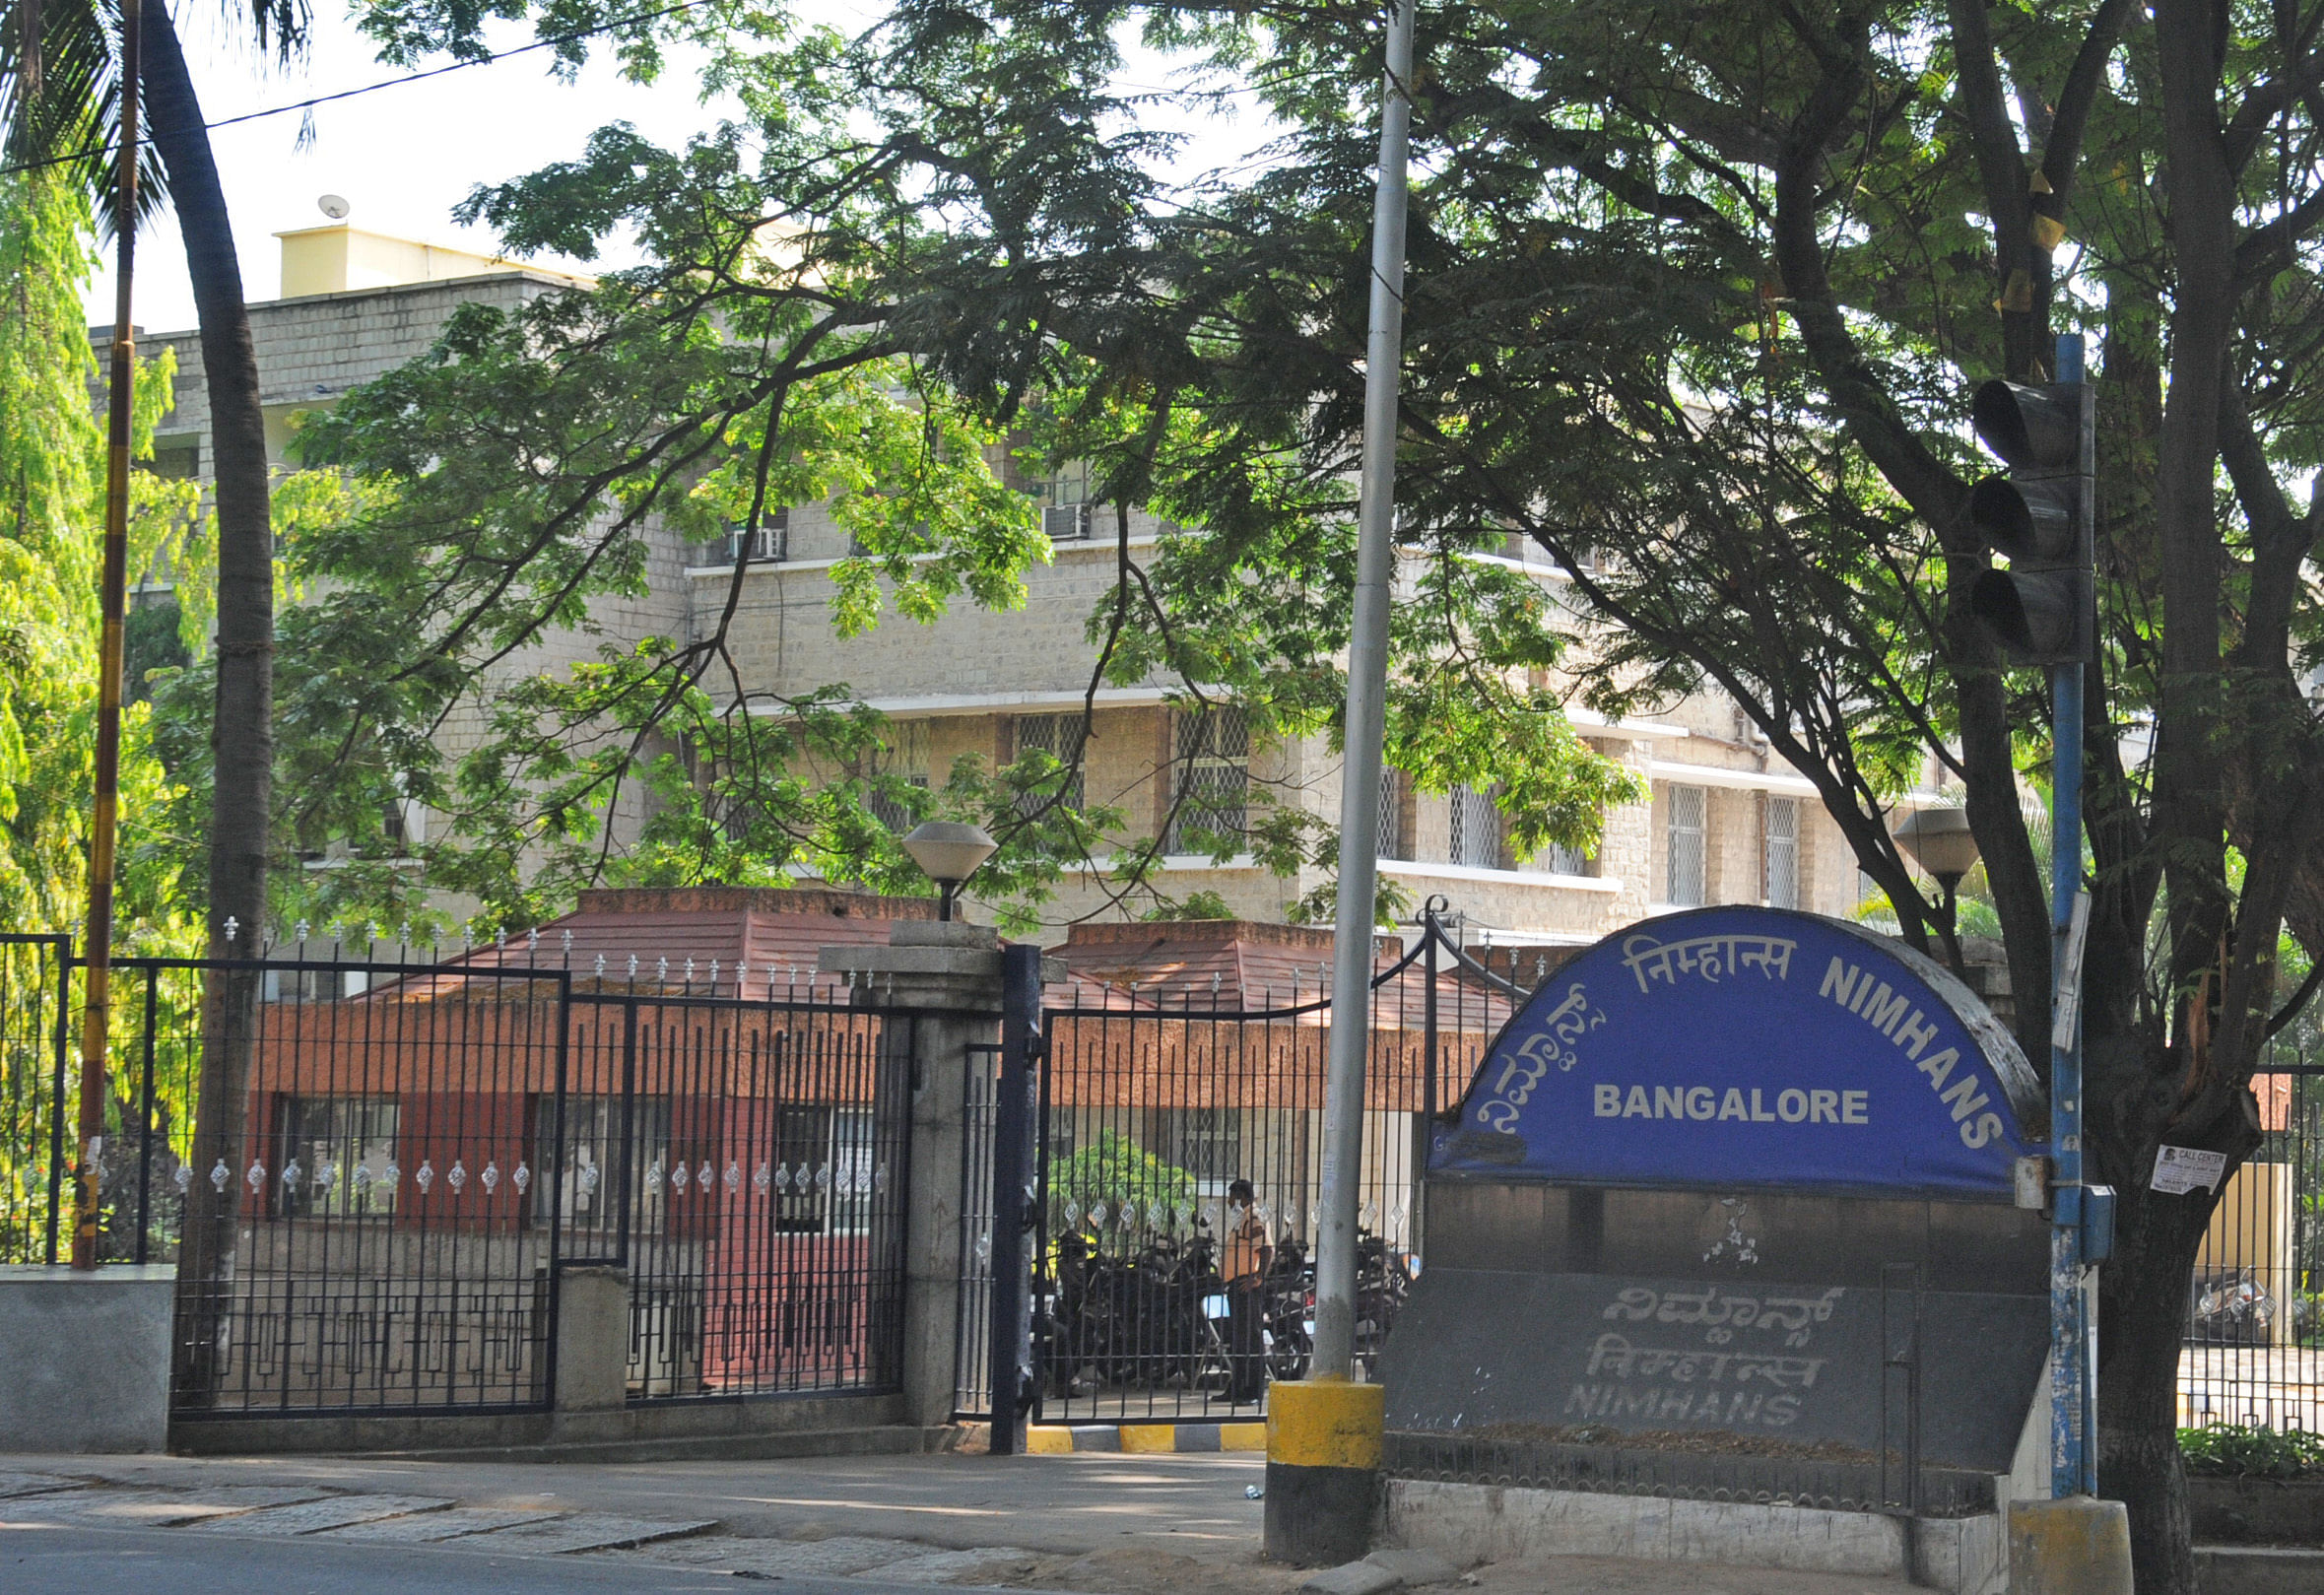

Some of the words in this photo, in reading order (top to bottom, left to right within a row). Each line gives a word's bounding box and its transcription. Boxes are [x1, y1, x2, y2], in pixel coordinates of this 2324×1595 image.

[1621, 935, 1798, 993] निम्हान्स
[1819, 956, 2003, 1149] NIMHANS
[1594, 1084, 1869, 1124] BANGALORE
[2178, 1149, 2196, 1161] CALL
[2198, 1152, 2224, 1164] CENTER
[1585, 1332, 1829, 1389] निम्हान्स
[1563, 1383, 1802, 1427] NIMHANS
